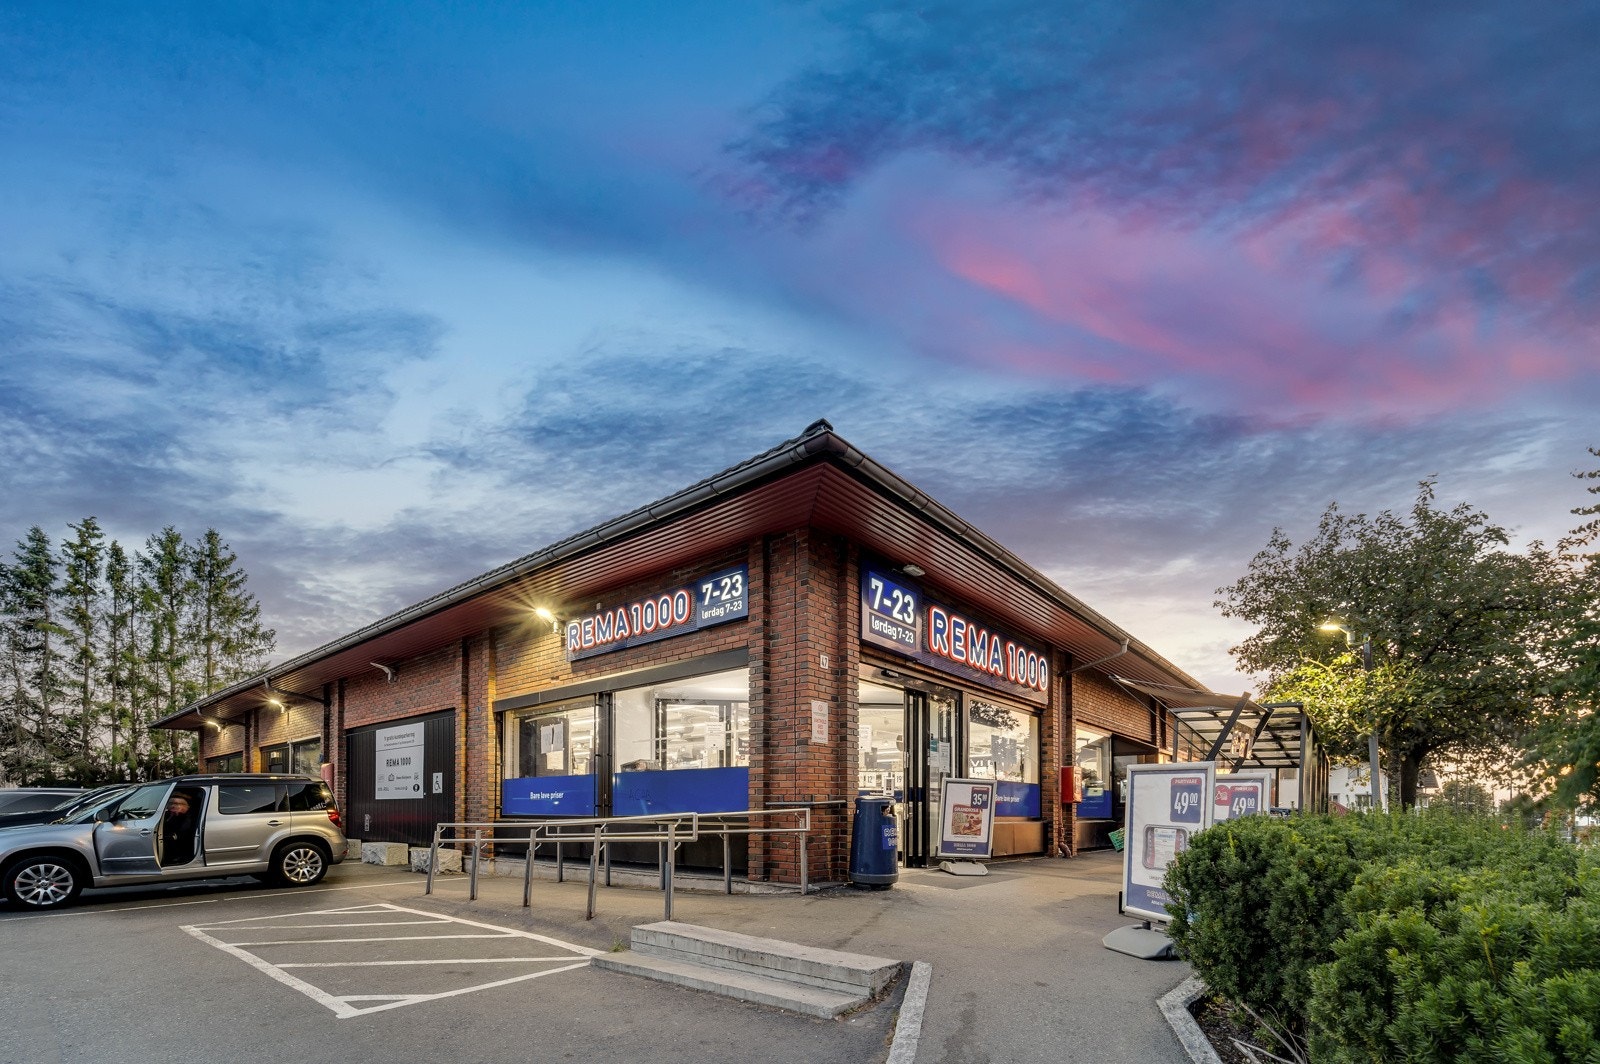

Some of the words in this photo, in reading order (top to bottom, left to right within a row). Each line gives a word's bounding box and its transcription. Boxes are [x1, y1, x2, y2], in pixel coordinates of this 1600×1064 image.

[702, 574, 743, 605] 7-23
[871, 577, 914, 625] 7-23
[567, 608, 630, 652] REMA
[631, 588, 691, 635] 1000
[701, 605, 725, 619] lørdag
[726, 600, 743, 613] 7-23
[871, 616, 897, 640] lørdag
[897, 628, 914, 644] 7-23
[928, 605, 1003, 676] REMA
[1005, 641, 1048, 692] 1000
[386, 758, 400, 768] REMA
[400, 757, 412, 766] 1000
[550, 792, 564, 800] priser
[972, 793, 982, 806] 35
[1174, 791, 1189, 815] 49
[1189, 792, 1198, 803] 00
[1232, 797, 1246, 815] 49
